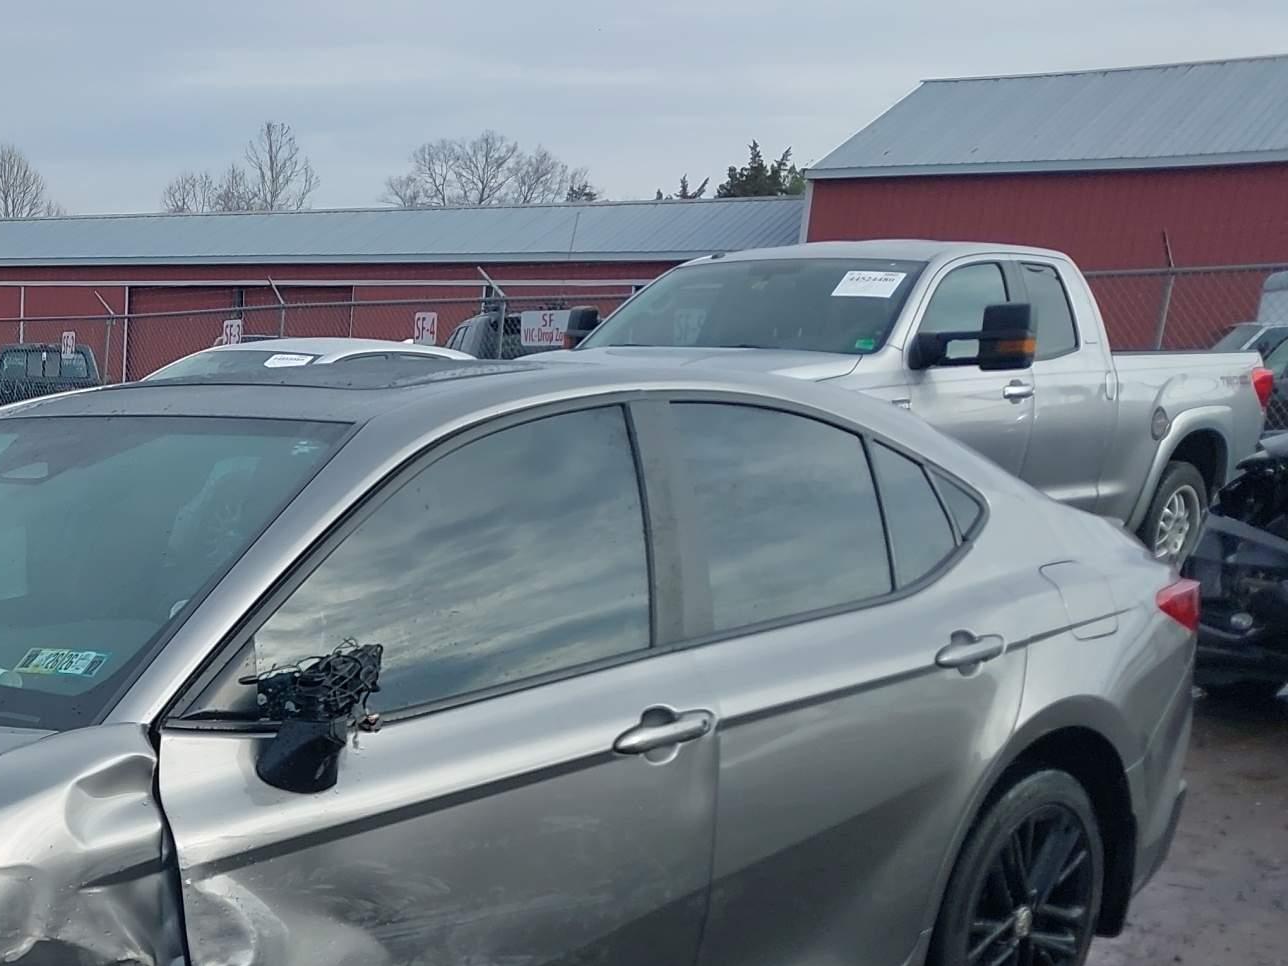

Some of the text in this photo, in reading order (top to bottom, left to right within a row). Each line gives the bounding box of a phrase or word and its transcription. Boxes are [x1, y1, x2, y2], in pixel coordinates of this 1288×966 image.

[415, 317, 435, 341] SF-4
[542, 313, 554, 328] SF
[224, 324, 240, 345] SF-3
